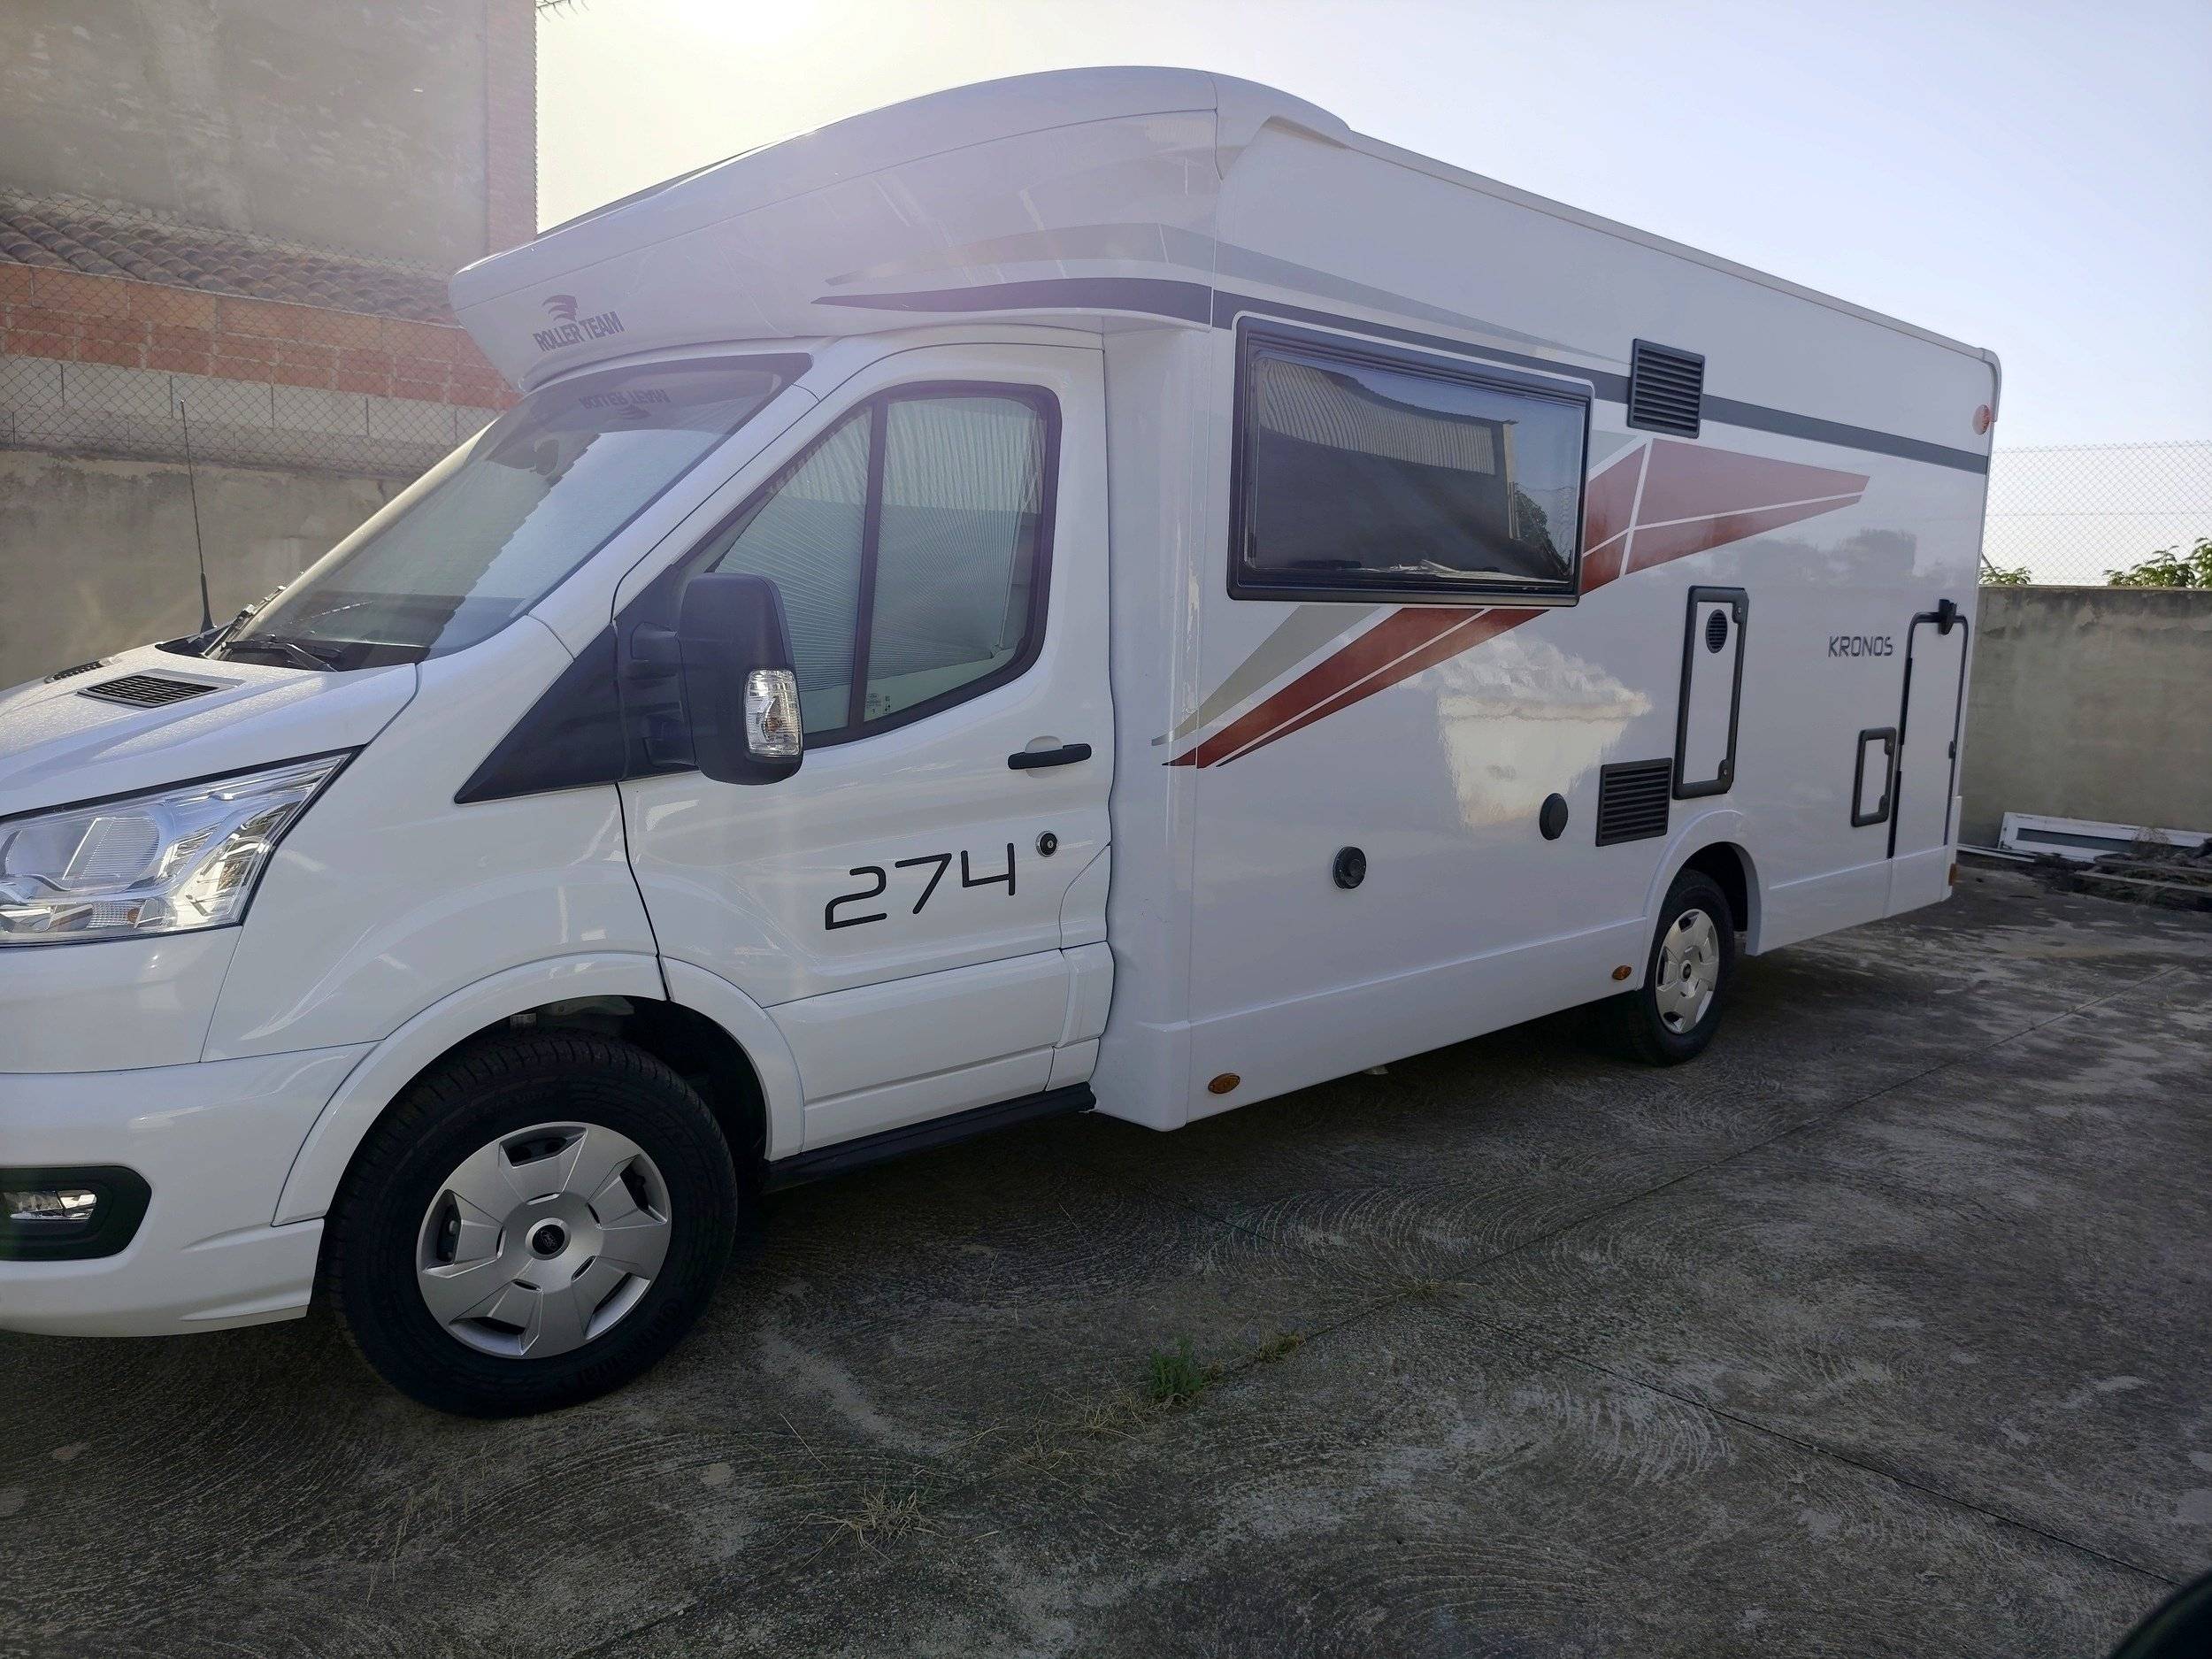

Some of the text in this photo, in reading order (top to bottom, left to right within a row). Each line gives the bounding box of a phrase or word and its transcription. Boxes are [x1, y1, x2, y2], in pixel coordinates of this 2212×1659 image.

[533, 311, 625, 351] ROLLER TEAM
[1828, 635, 1893, 657] KRONOS
[825, 843, 1015, 930] 274
